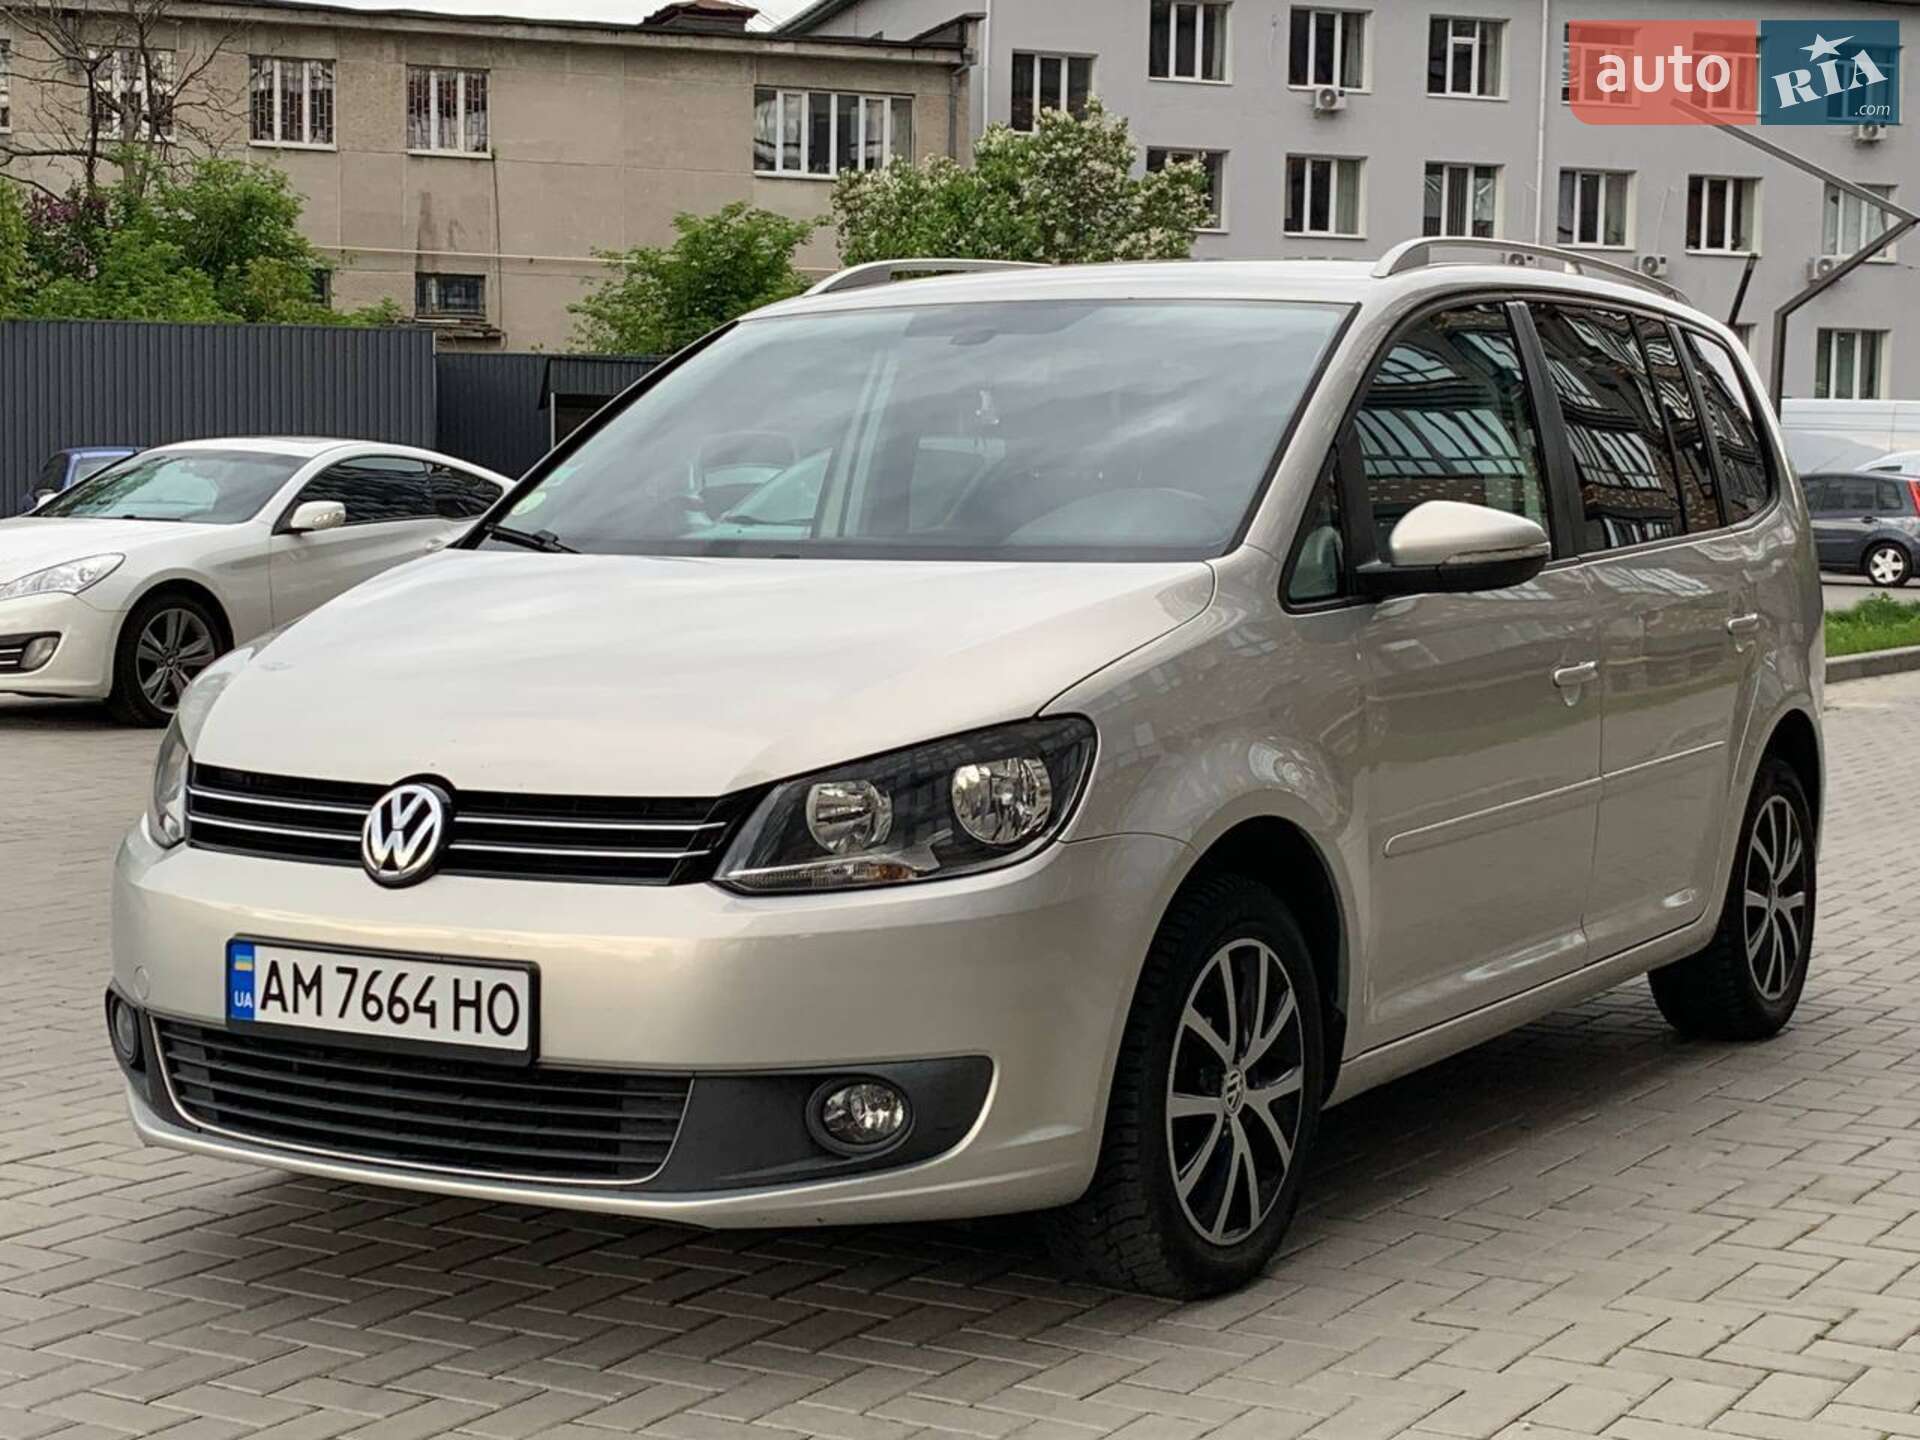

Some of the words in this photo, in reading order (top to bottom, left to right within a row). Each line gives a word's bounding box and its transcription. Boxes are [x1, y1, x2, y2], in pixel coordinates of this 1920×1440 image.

[365, 786, 440, 875] VW
[234, 991, 254, 1009] UA
[260, 960, 323, 1017] AM
[335, 966, 437, 1029] 7664
[453, 978, 520, 1037] HO
